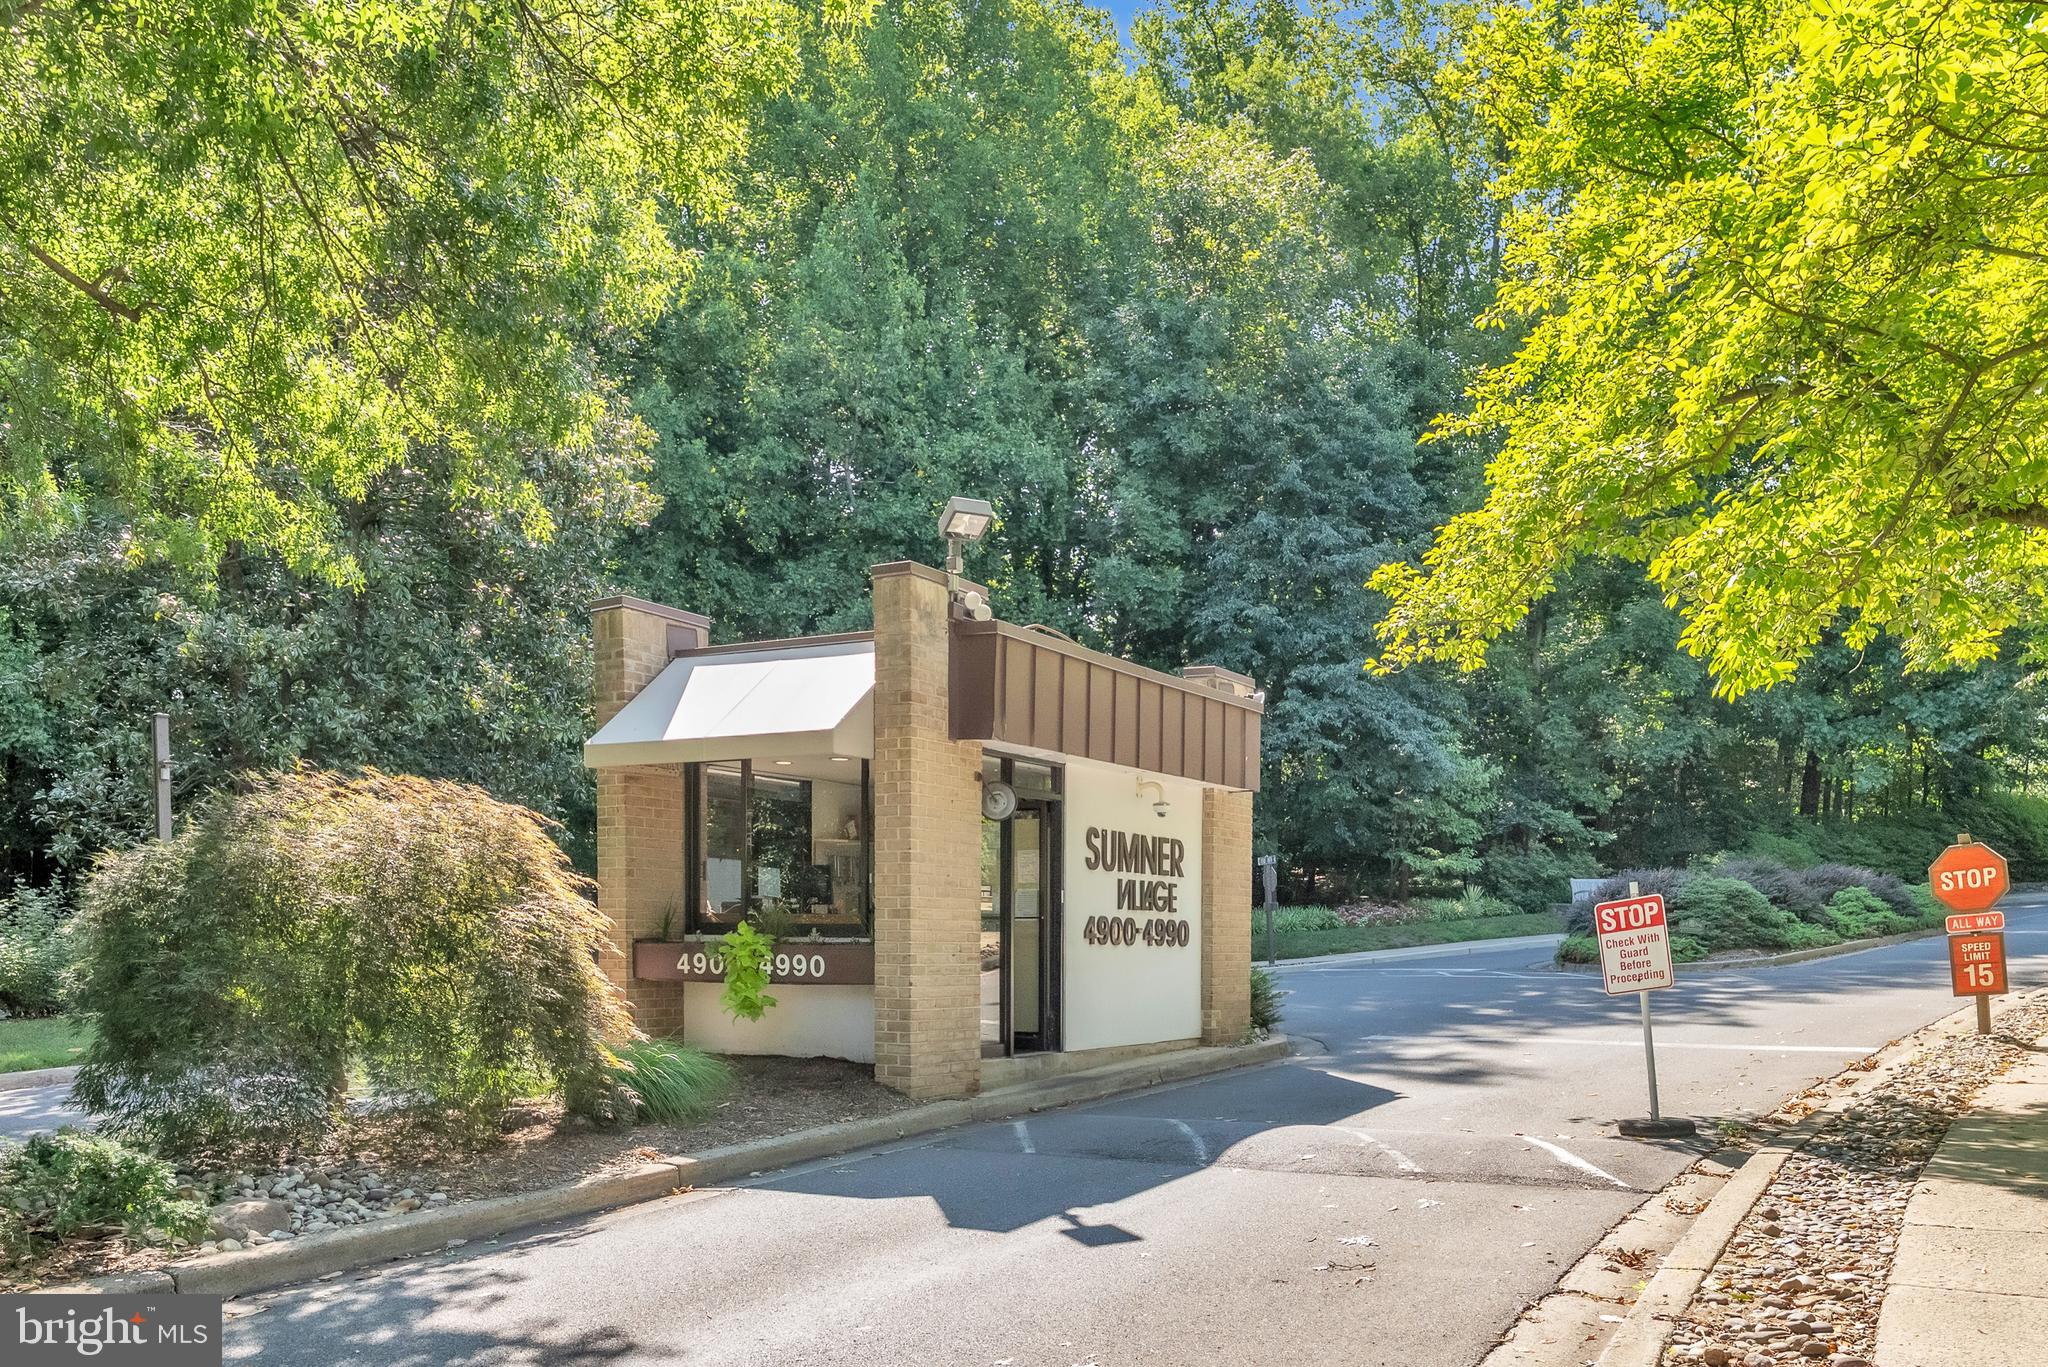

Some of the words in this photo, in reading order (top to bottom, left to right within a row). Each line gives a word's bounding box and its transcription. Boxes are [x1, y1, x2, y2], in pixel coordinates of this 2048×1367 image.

[1085, 826, 1185, 878] SUMNER
[1940, 867, 1997, 891] STOP
[1601, 901, 1659, 931] STOP
[1952, 918, 1972, 929] ALL
[1976, 916, 1998, 927] WAY
[1083, 915, 1190, 948] 4900-4990
[1605, 936, 1635, 949] Check
[1637, 933, 1660, 945] With
[1961, 942, 1991, 952] SPEED
[1620, 946, 1649, 959] Guard
[1963, 951, 1991, 962] LIMIT
[1620, 959, 1652, 971] Before
[1610, 969, 1665, 984] Proceeding
[1963, 963, 1995, 987] 15
